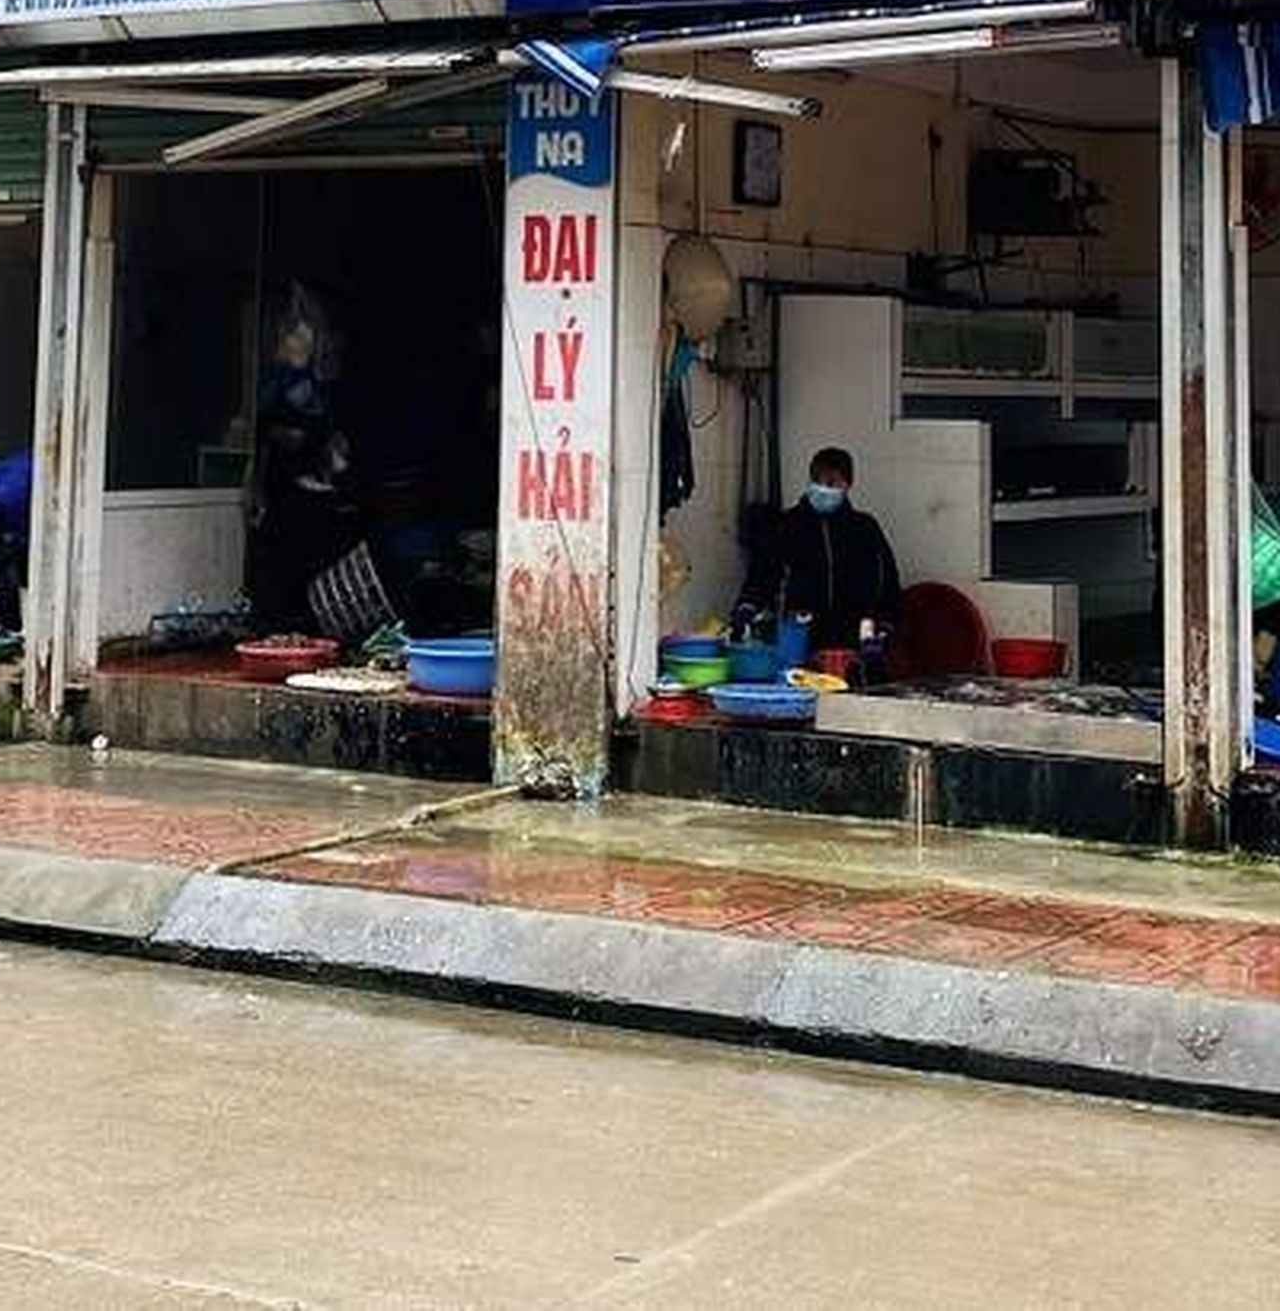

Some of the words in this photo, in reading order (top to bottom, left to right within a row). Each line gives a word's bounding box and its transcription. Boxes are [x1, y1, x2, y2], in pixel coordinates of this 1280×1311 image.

[536, 130, 585, 168] NA
[521, 214, 597, 300] ĐẠI
[533, 315, 584, 401] LÝ
[518, 425, 595, 522] HẢI
